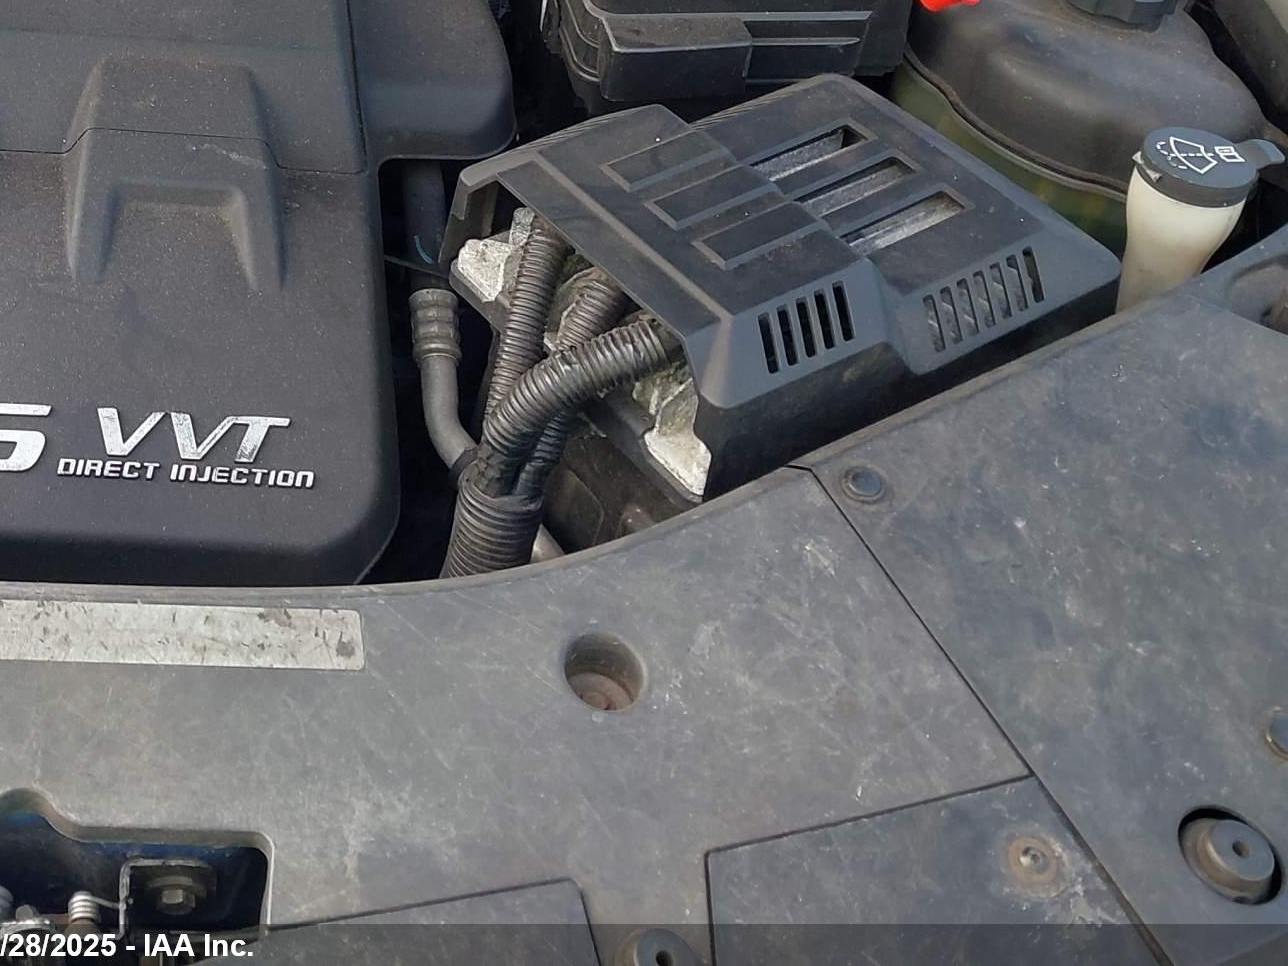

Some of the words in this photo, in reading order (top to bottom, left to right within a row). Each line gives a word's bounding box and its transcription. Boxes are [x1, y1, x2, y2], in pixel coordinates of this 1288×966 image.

[97, 407, 291, 463] VVT
[57, 457, 160, 480] DIRECT
[169, 463, 314, 488] INJECTION
